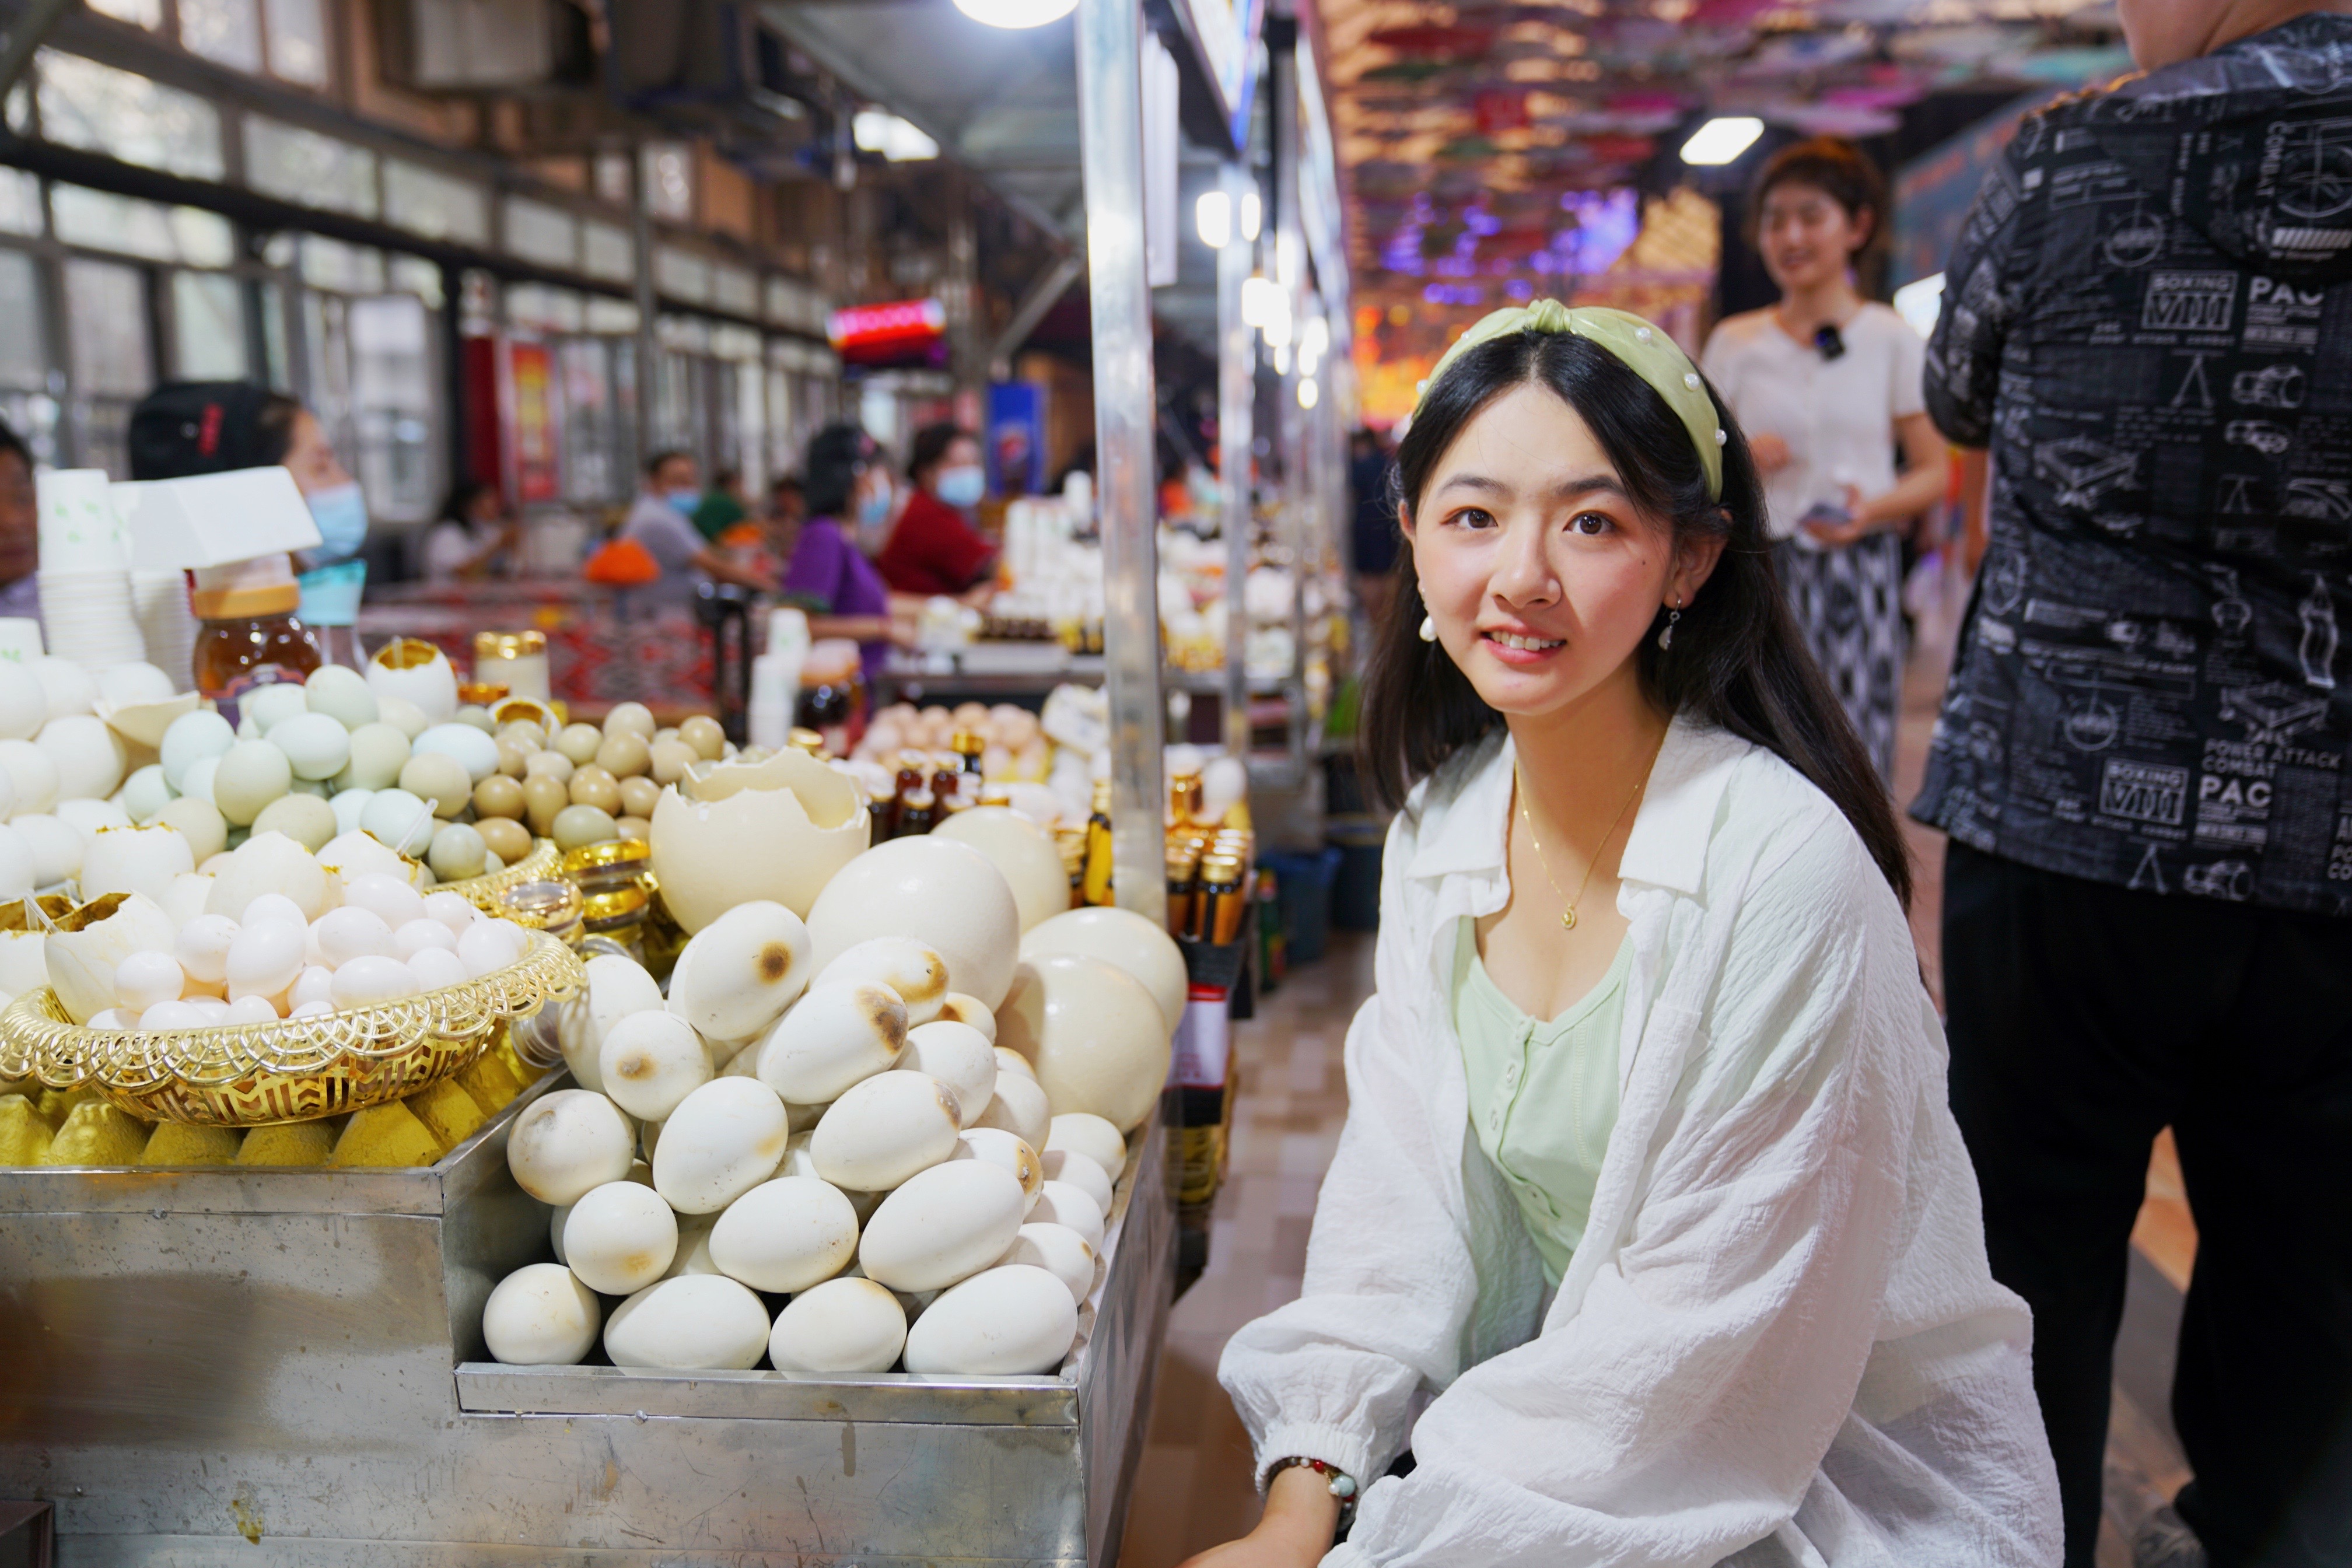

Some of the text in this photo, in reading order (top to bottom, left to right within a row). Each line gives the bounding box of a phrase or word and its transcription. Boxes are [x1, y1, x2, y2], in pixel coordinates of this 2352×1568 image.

[2255, 120, 2290, 197] COMBAT
[2152, 275, 2230, 290] BOXING
[2201, 754, 2277, 779] COMBAT
[2204, 737, 2342, 769] POWER ATTACK
[2108, 764, 2183, 788] BOXING
[2198, 775, 2273, 808] PAC
